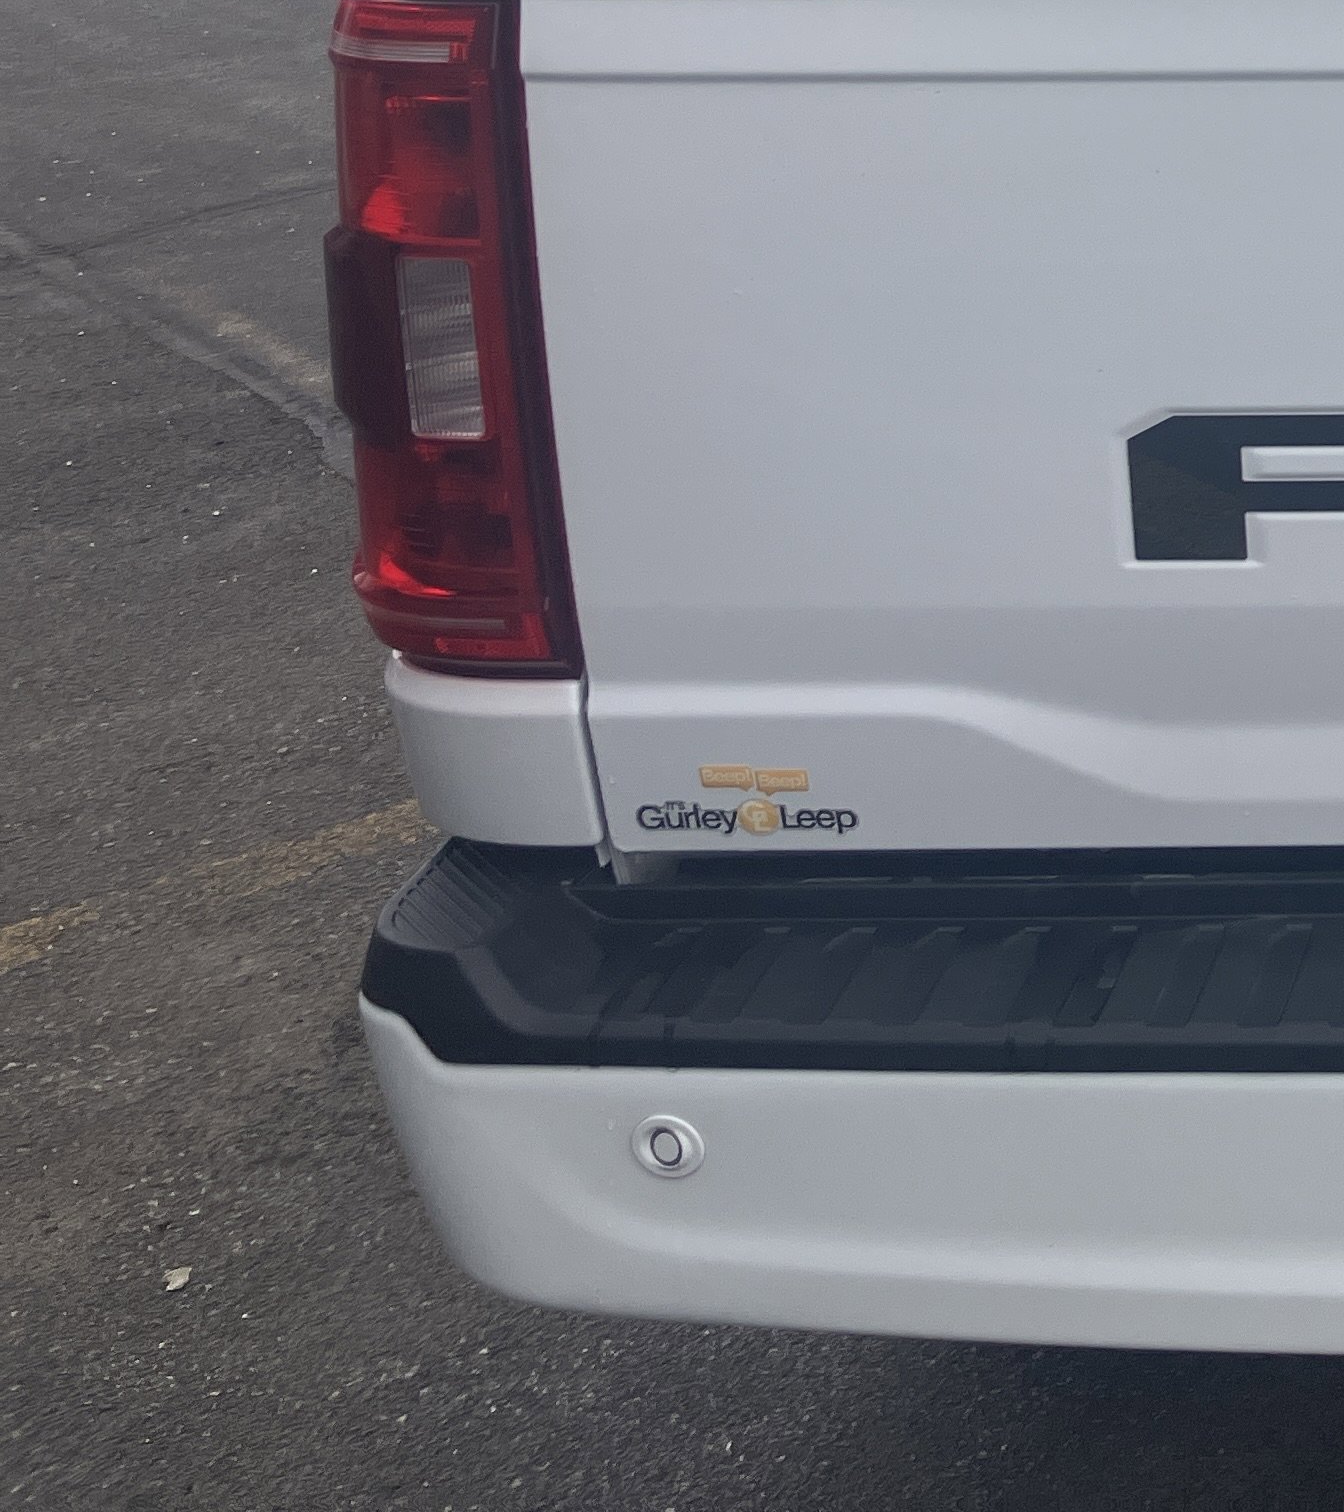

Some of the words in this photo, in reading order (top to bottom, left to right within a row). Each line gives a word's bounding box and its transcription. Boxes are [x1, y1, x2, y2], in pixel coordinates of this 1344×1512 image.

[702, 767, 750, 785] Beep!
[760, 773, 805, 791] Beep!
[636, 803, 738, 834] Gurley
[780, 804, 858, 834] Leep
